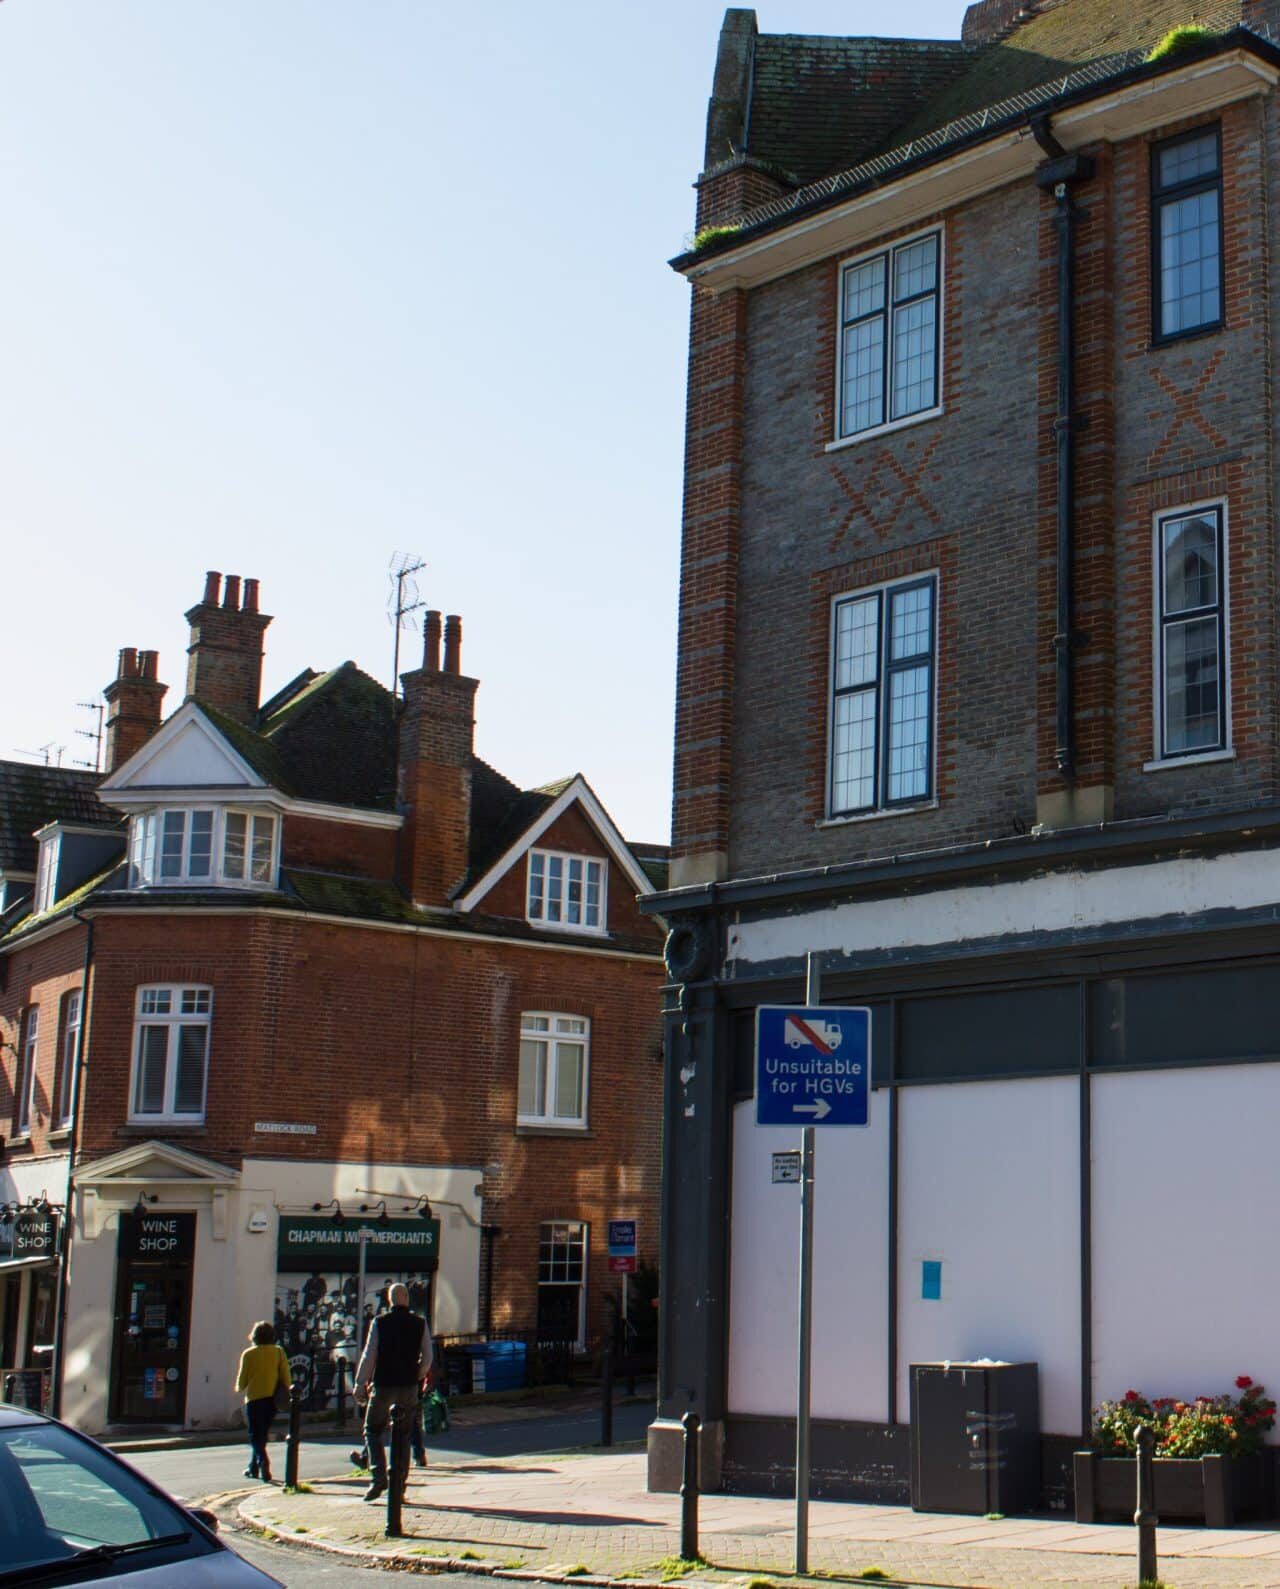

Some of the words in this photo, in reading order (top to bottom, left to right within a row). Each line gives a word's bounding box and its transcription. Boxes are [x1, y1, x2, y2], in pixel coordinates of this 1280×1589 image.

[765, 1058, 862, 1075] Unsuitable
[772, 1078, 798, 1094] for
[805, 1078, 855, 1094] HGVs
[20, 1222, 52, 1233] WINE
[142, 1220, 177, 1233] WINE
[17, 1236, 52, 1249] SHOP
[139, 1237, 177, 1251] SHOP
[288, 1229, 342, 1243] CHAPMAN
[373, 1231, 433, 1245] MERCHANTS
